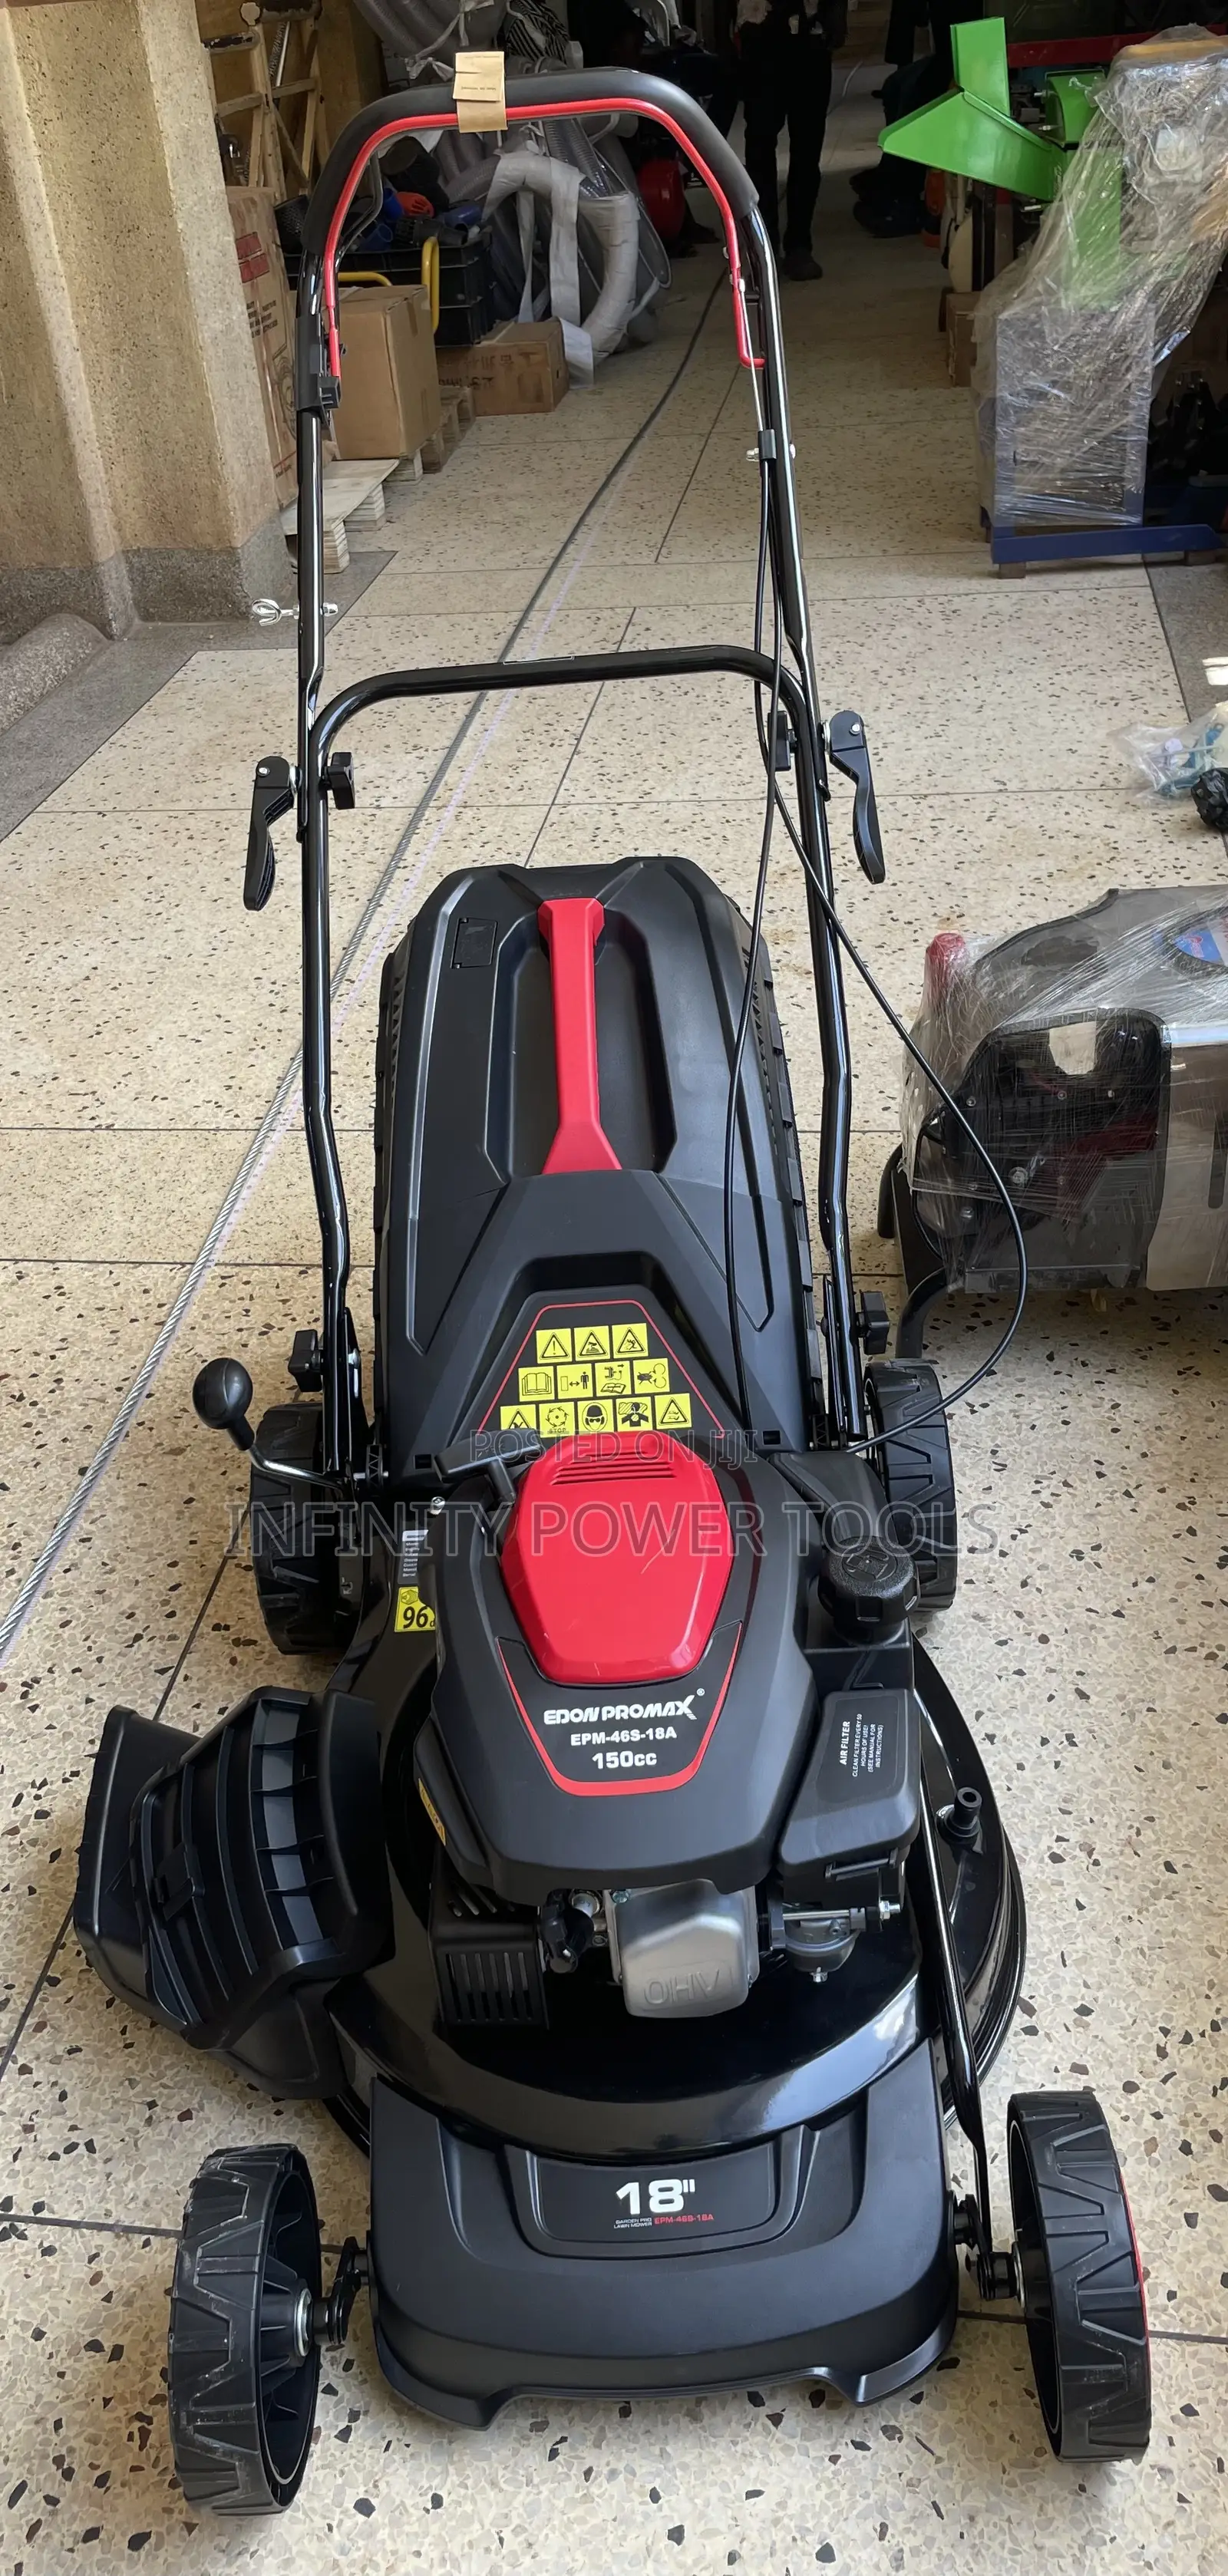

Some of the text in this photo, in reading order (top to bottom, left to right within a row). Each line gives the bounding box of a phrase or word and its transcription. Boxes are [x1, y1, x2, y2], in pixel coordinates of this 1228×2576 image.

[403, 1606, 428, 1628] 96
[570, 1726, 677, 1746] EPM-46S-18A
[840, 1721, 850, 1765] AIR FILTER
[862, 1737, 867, 1746] OF
[592, 1750, 658, 1770] 150cc
